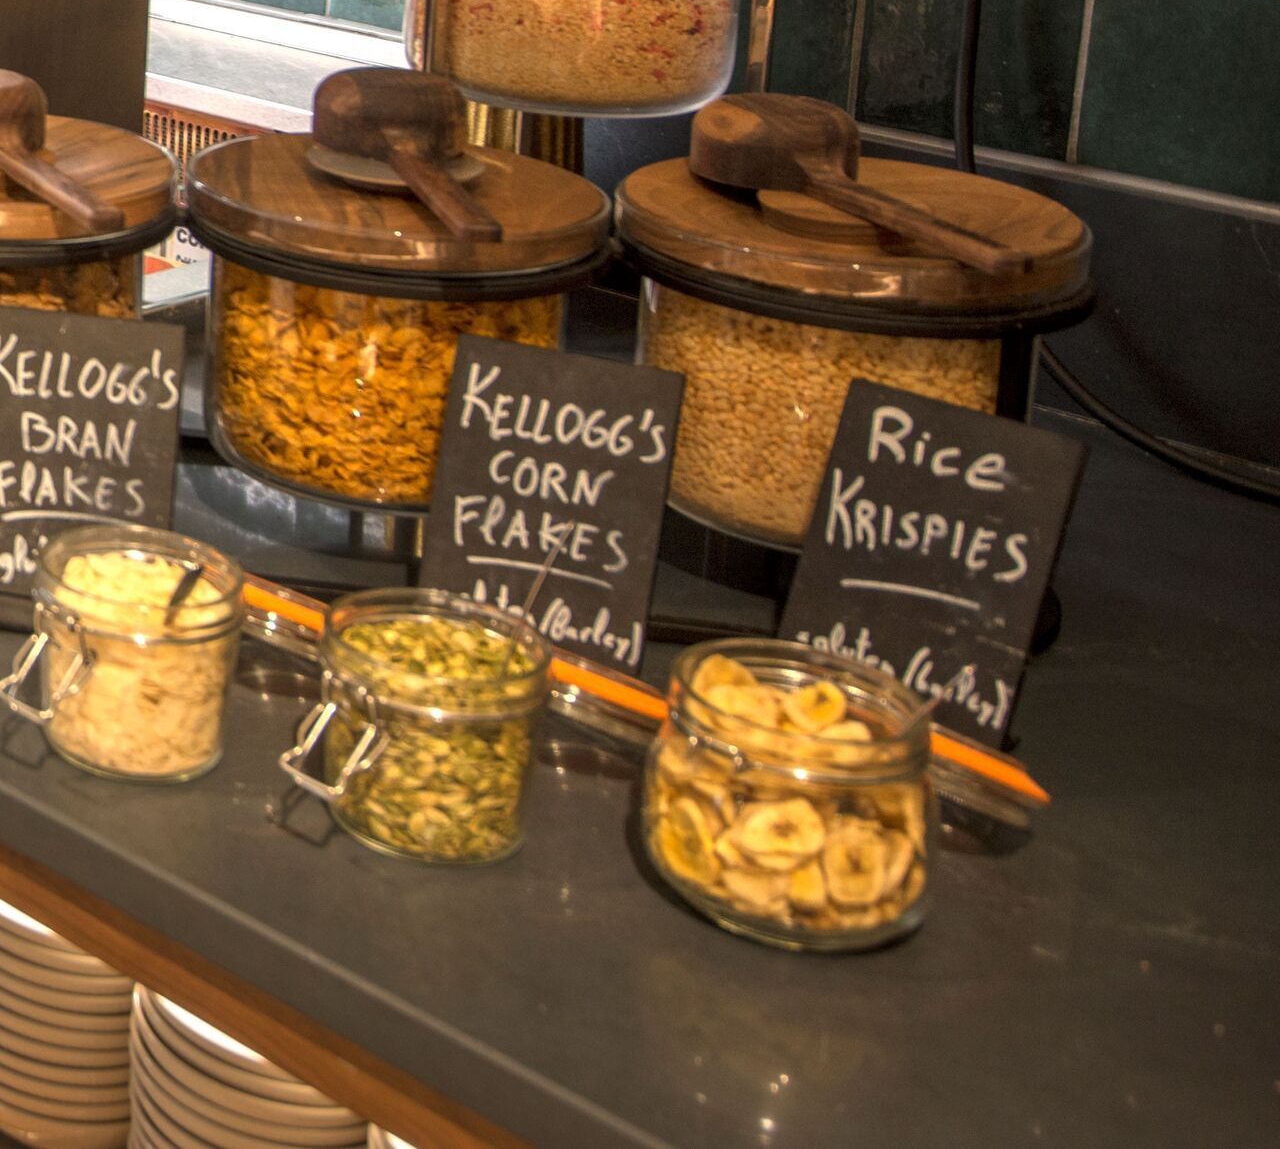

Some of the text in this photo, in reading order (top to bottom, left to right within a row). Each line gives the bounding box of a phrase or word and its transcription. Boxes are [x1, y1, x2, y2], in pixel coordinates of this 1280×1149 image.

[21, 411, 137, 467] BRAN
[867, 406, 1007, 491] Rice
[489, 450, 614, 506] CORN
[825, 468, 1028, 583] KRISPIES
